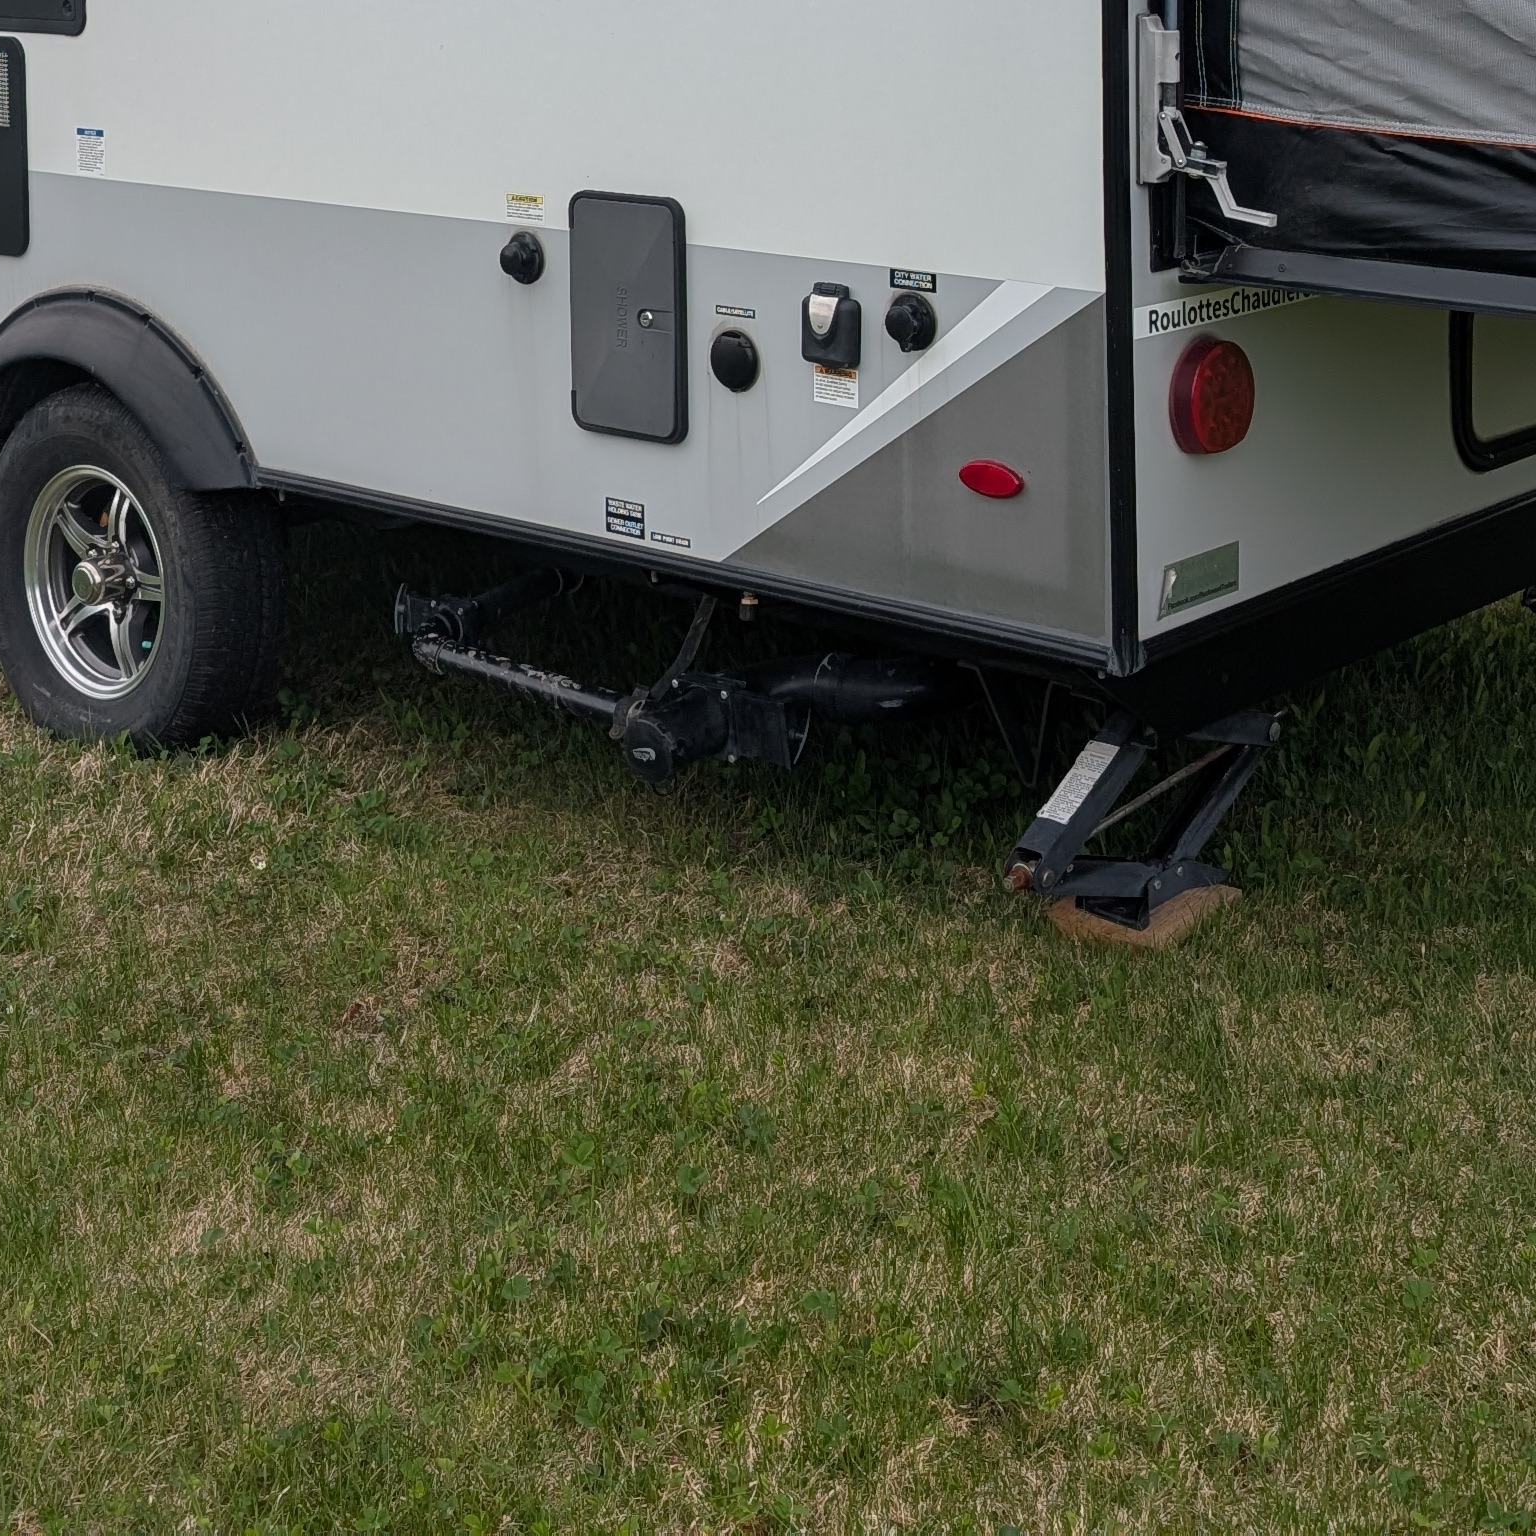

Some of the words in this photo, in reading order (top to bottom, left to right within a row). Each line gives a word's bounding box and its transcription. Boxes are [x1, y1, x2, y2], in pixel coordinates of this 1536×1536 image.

[894, 271, 909, 279] CITY
[910, 272, 932, 282] WATER
[894, 277, 933, 290] CONNECTION
[616, 286, 628, 348] SHOWER
